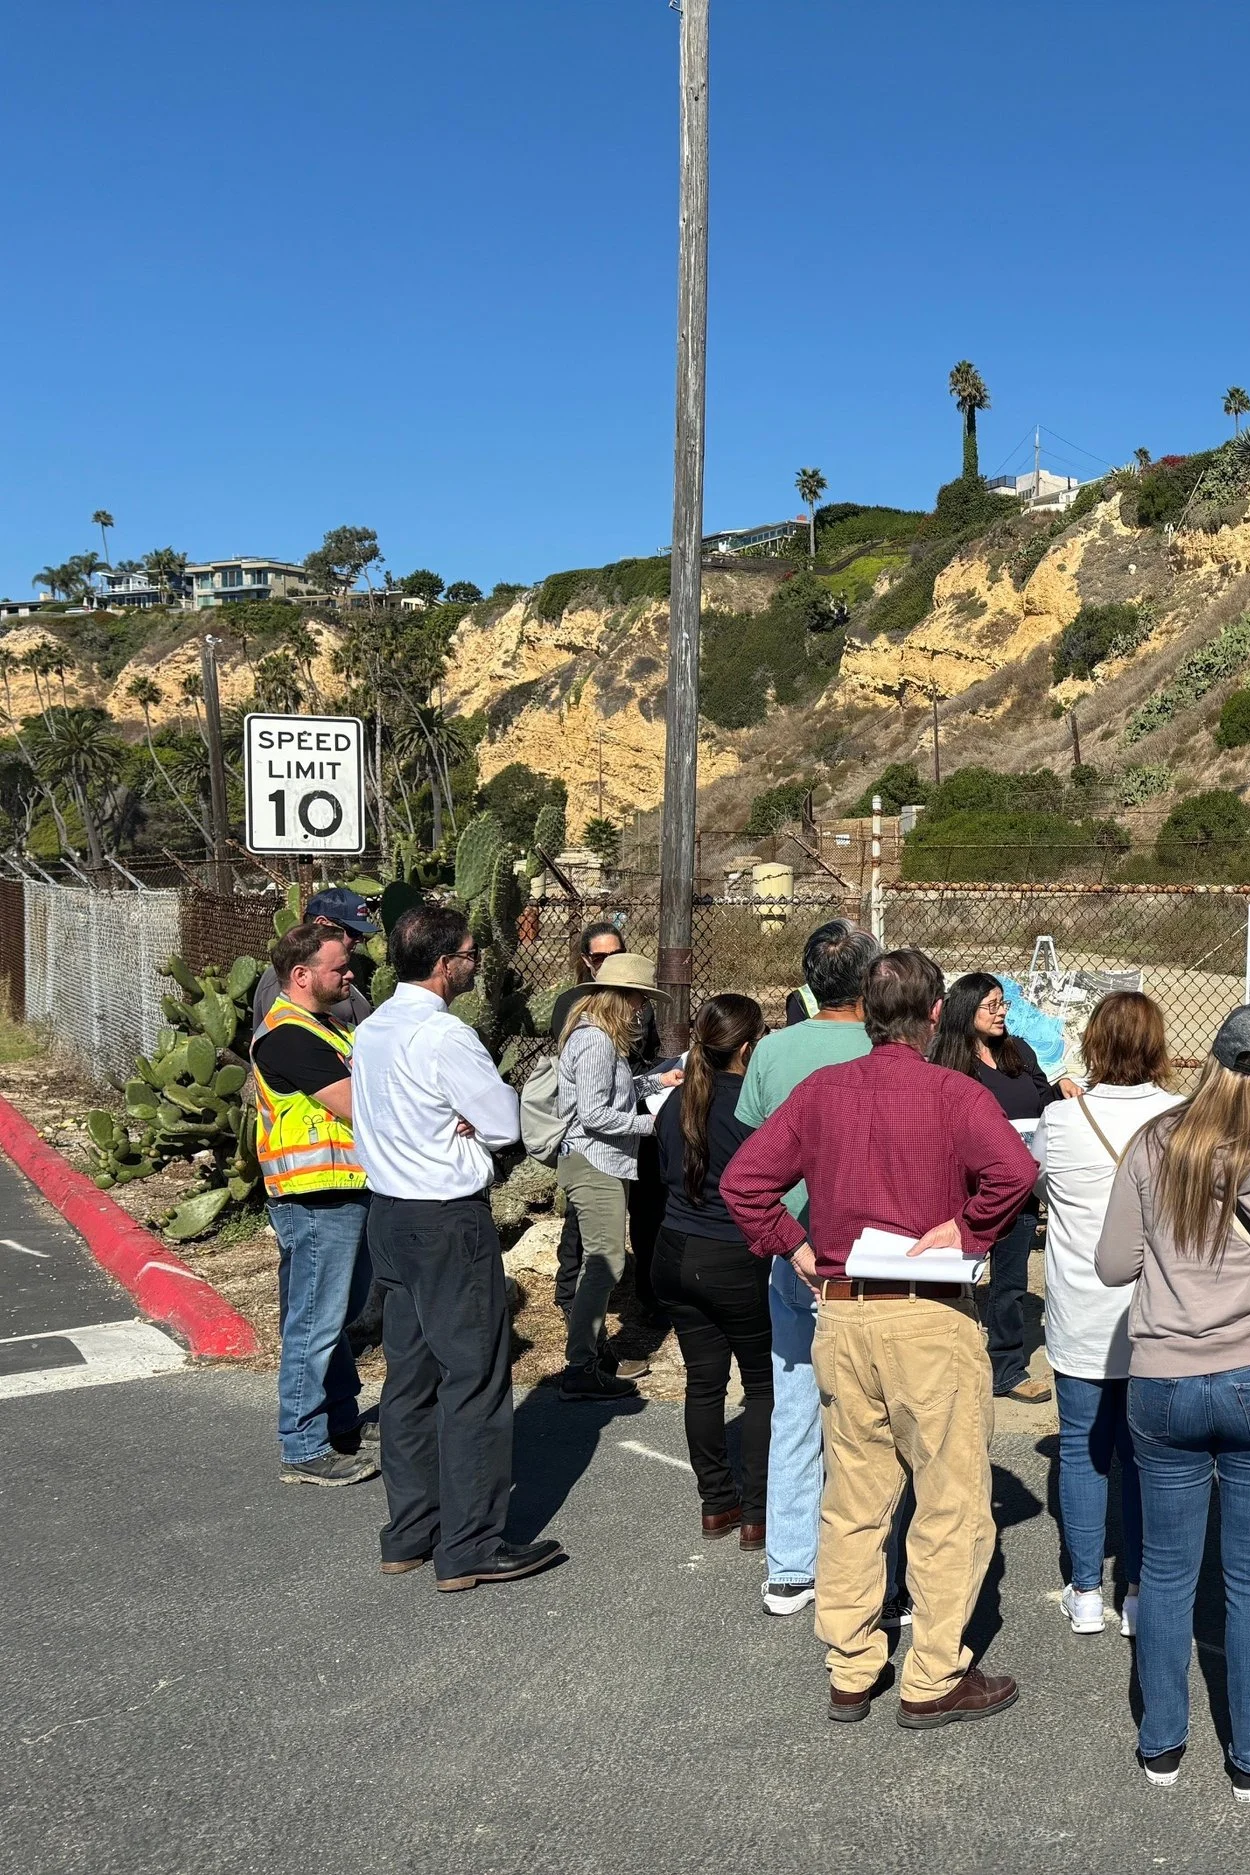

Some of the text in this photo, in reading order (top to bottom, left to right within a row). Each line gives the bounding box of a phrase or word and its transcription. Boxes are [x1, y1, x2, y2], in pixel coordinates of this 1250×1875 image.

[258, 730, 351, 751] SPEED
[268, 760, 341, 780] LIMIT
[268, 789, 343, 838] 10
